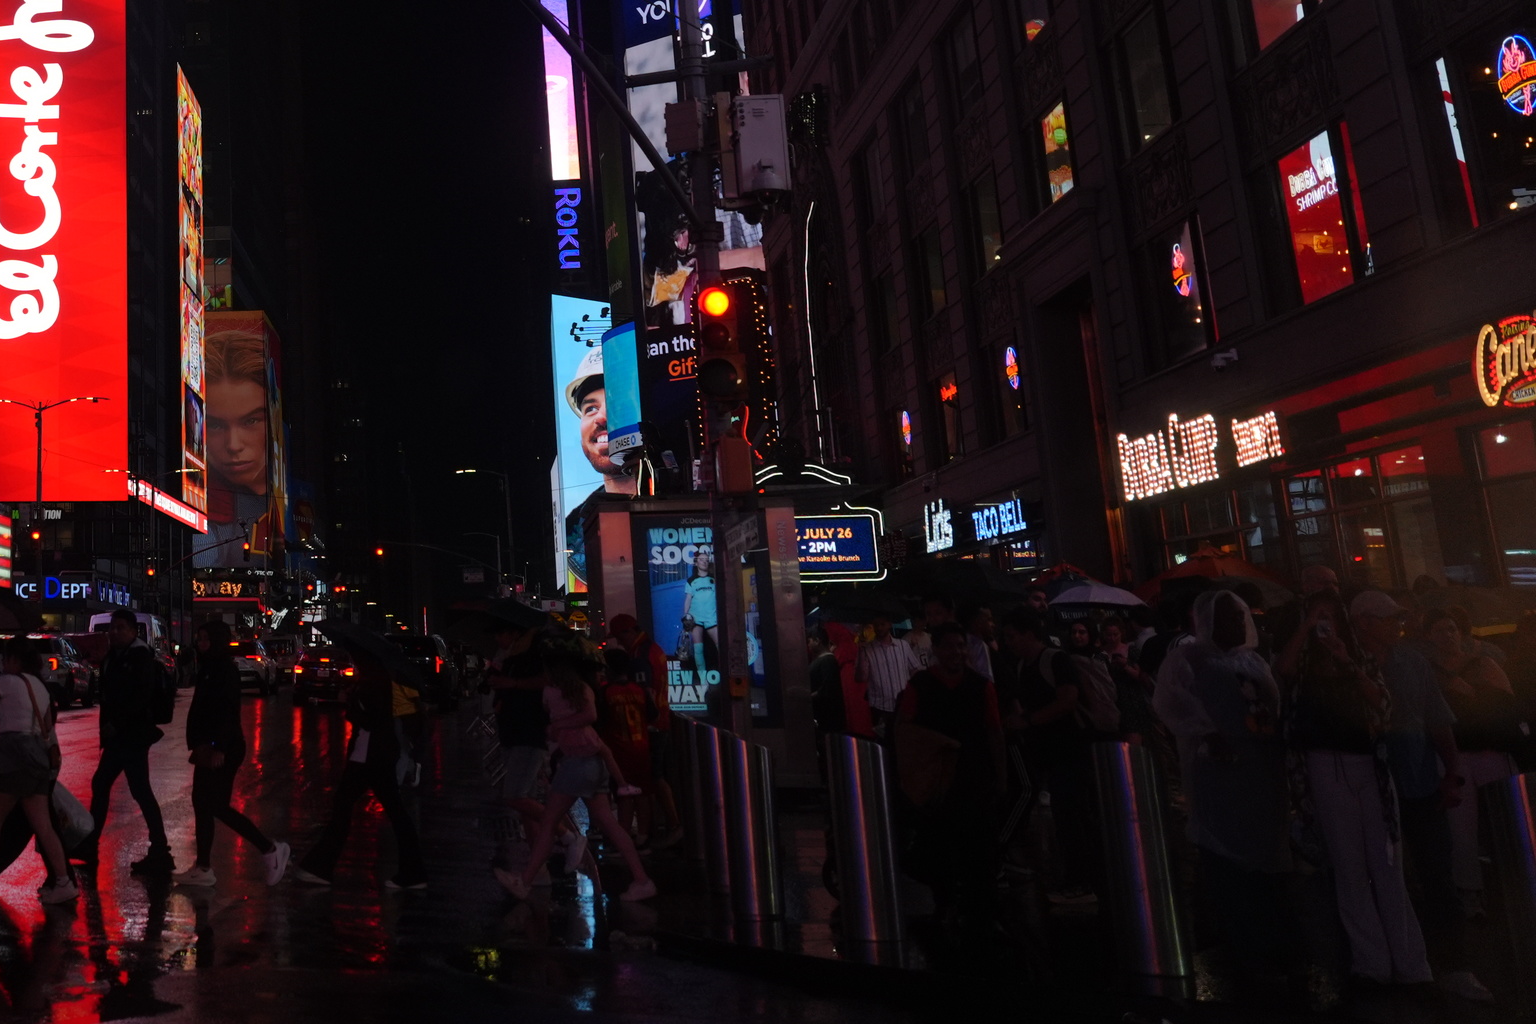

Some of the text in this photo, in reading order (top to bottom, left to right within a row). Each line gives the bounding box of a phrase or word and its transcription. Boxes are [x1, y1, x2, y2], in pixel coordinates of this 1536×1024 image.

[1296, 185, 1327, 212] SHRIMP
[646, 340, 670, 358] an
[668, 356, 696, 377] Gif
[615, 437, 630, 450] CHASE
[680, 516, 712, 526] JCDecau
[924, 498, 1027, 554] Lids TACO BELL
[803, 527, 853, 539] JULY 26
[808, 541, 837, 553] 2PM
[806, 555, 830, 563] Karaoke
[838, 554, 861, 562] Brunch
[46, 576, 89, 599] DEPT
